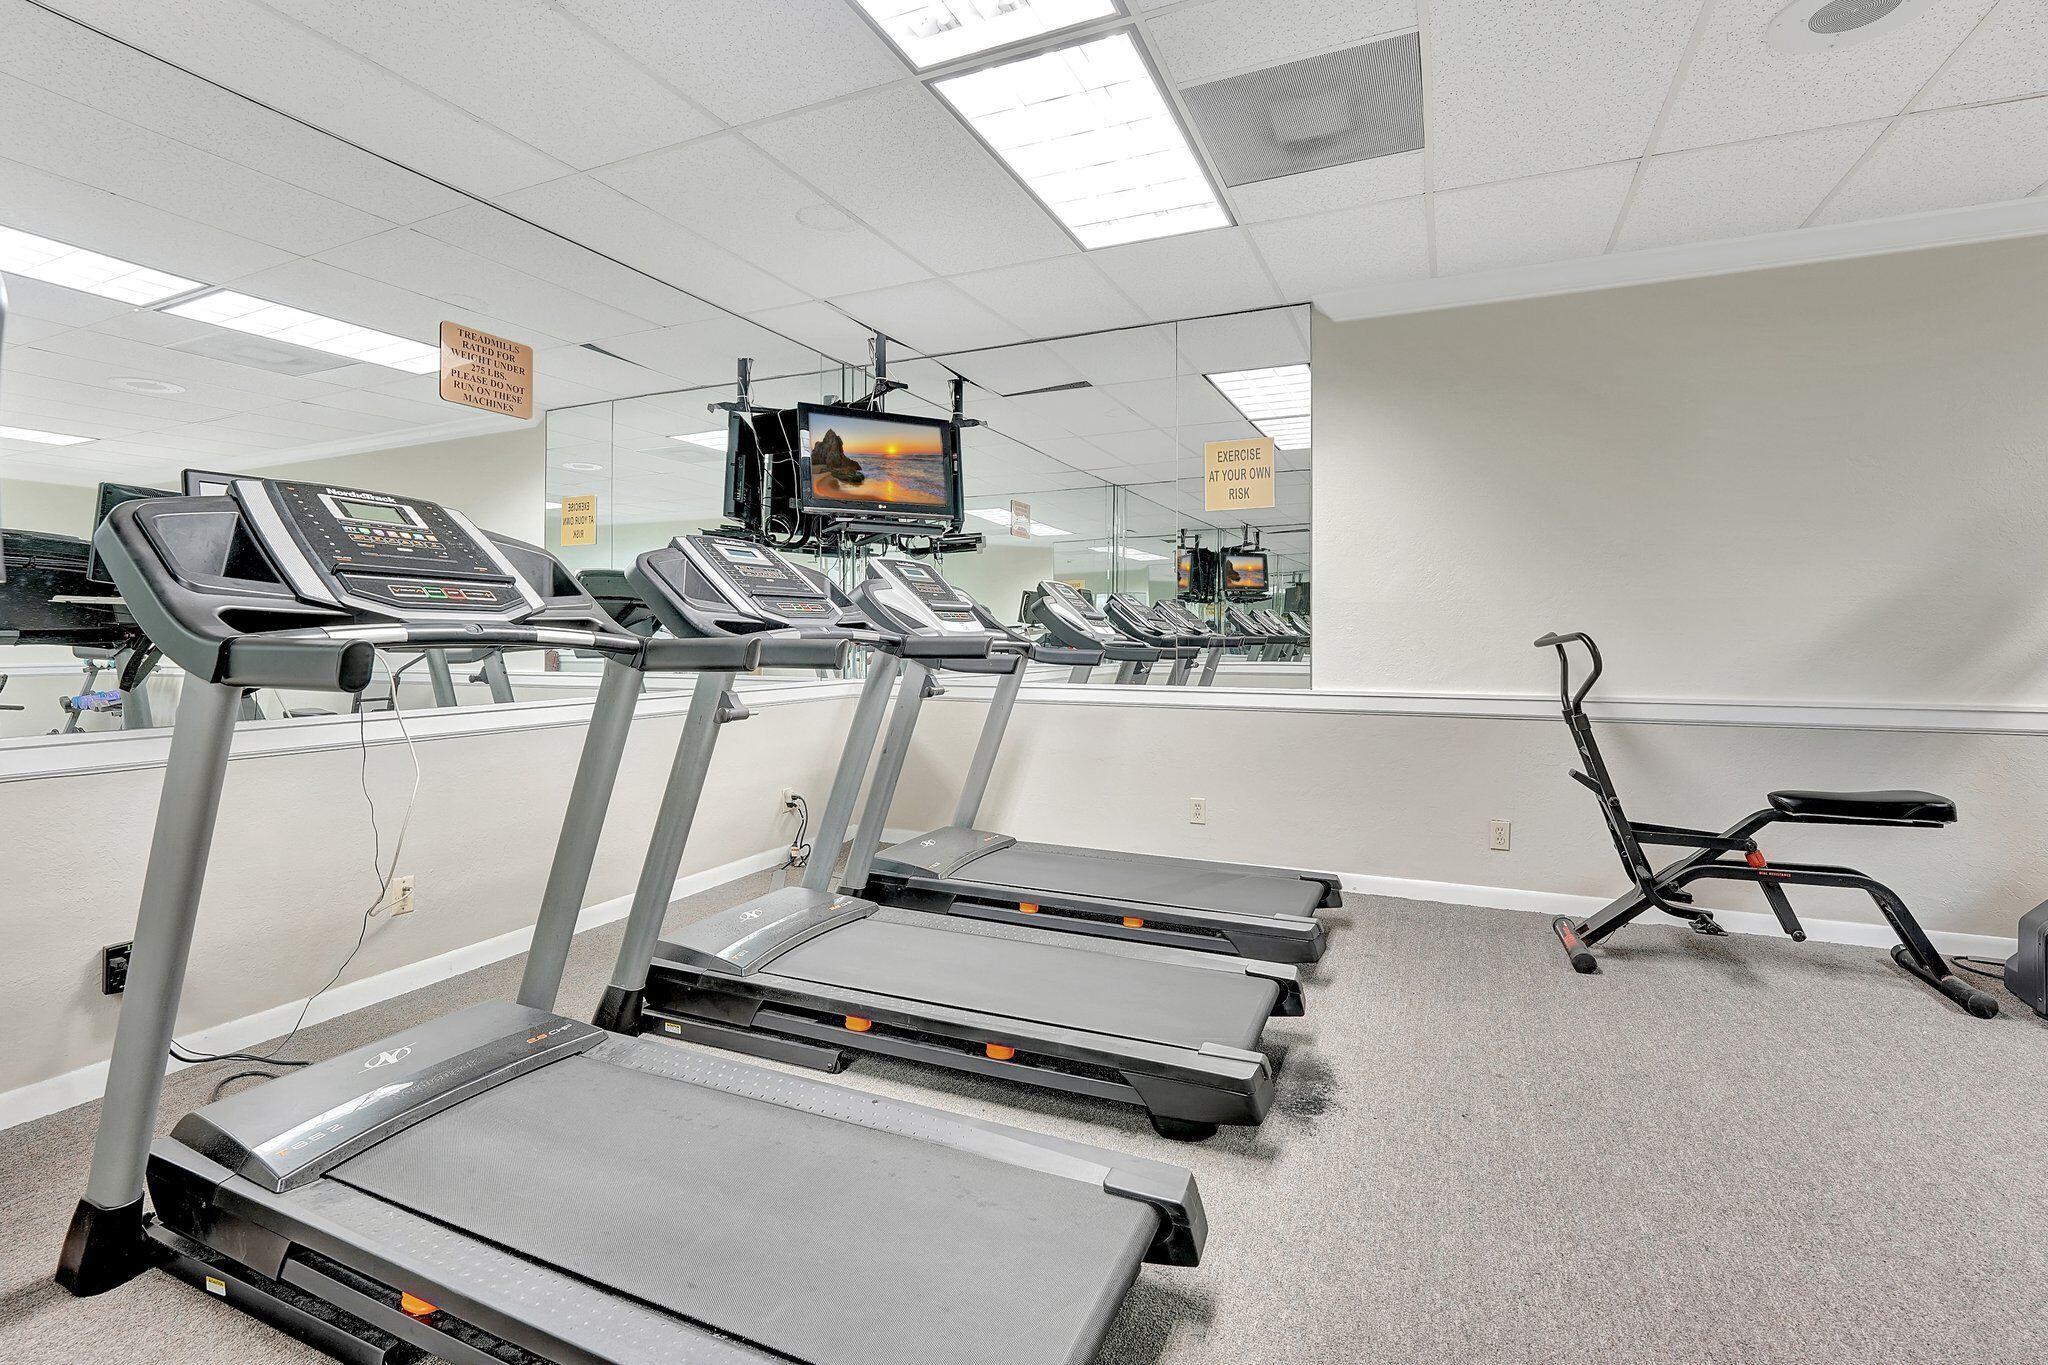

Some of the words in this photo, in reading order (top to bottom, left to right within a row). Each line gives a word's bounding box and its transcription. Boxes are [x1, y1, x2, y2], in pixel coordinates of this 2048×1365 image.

[457, 328, 520, 354] TREADMILLS
[462, 340, 495, 356] RATED
[496, 351, 516, 362] FOR
[471, 364, 486, 375] 275
[487, 368, 507, 381] LBS.
[493, 360, 526, 376] UNDER
[451, 369, 488, 386] PLEASE
[490, 379, 504, 390] DO
[506, 384, 526, 395] NOT
[453, 380, 475, 393] RUN
[476, 386, 491, 397] ON
[493, 390, 523, 405] THESE
[463, 393, 514, 412] MACHINES
[1217, 447, 1261, 463] EXERCISE
[1209, 470, 1219, 482] AT
[1222, 468, 1247, 481] YOUR
[1249, 466, 1271, 479] OWN
[325, 486, 397, 504] NordicTrack
[1229, 487, 1250, 500] RISK
